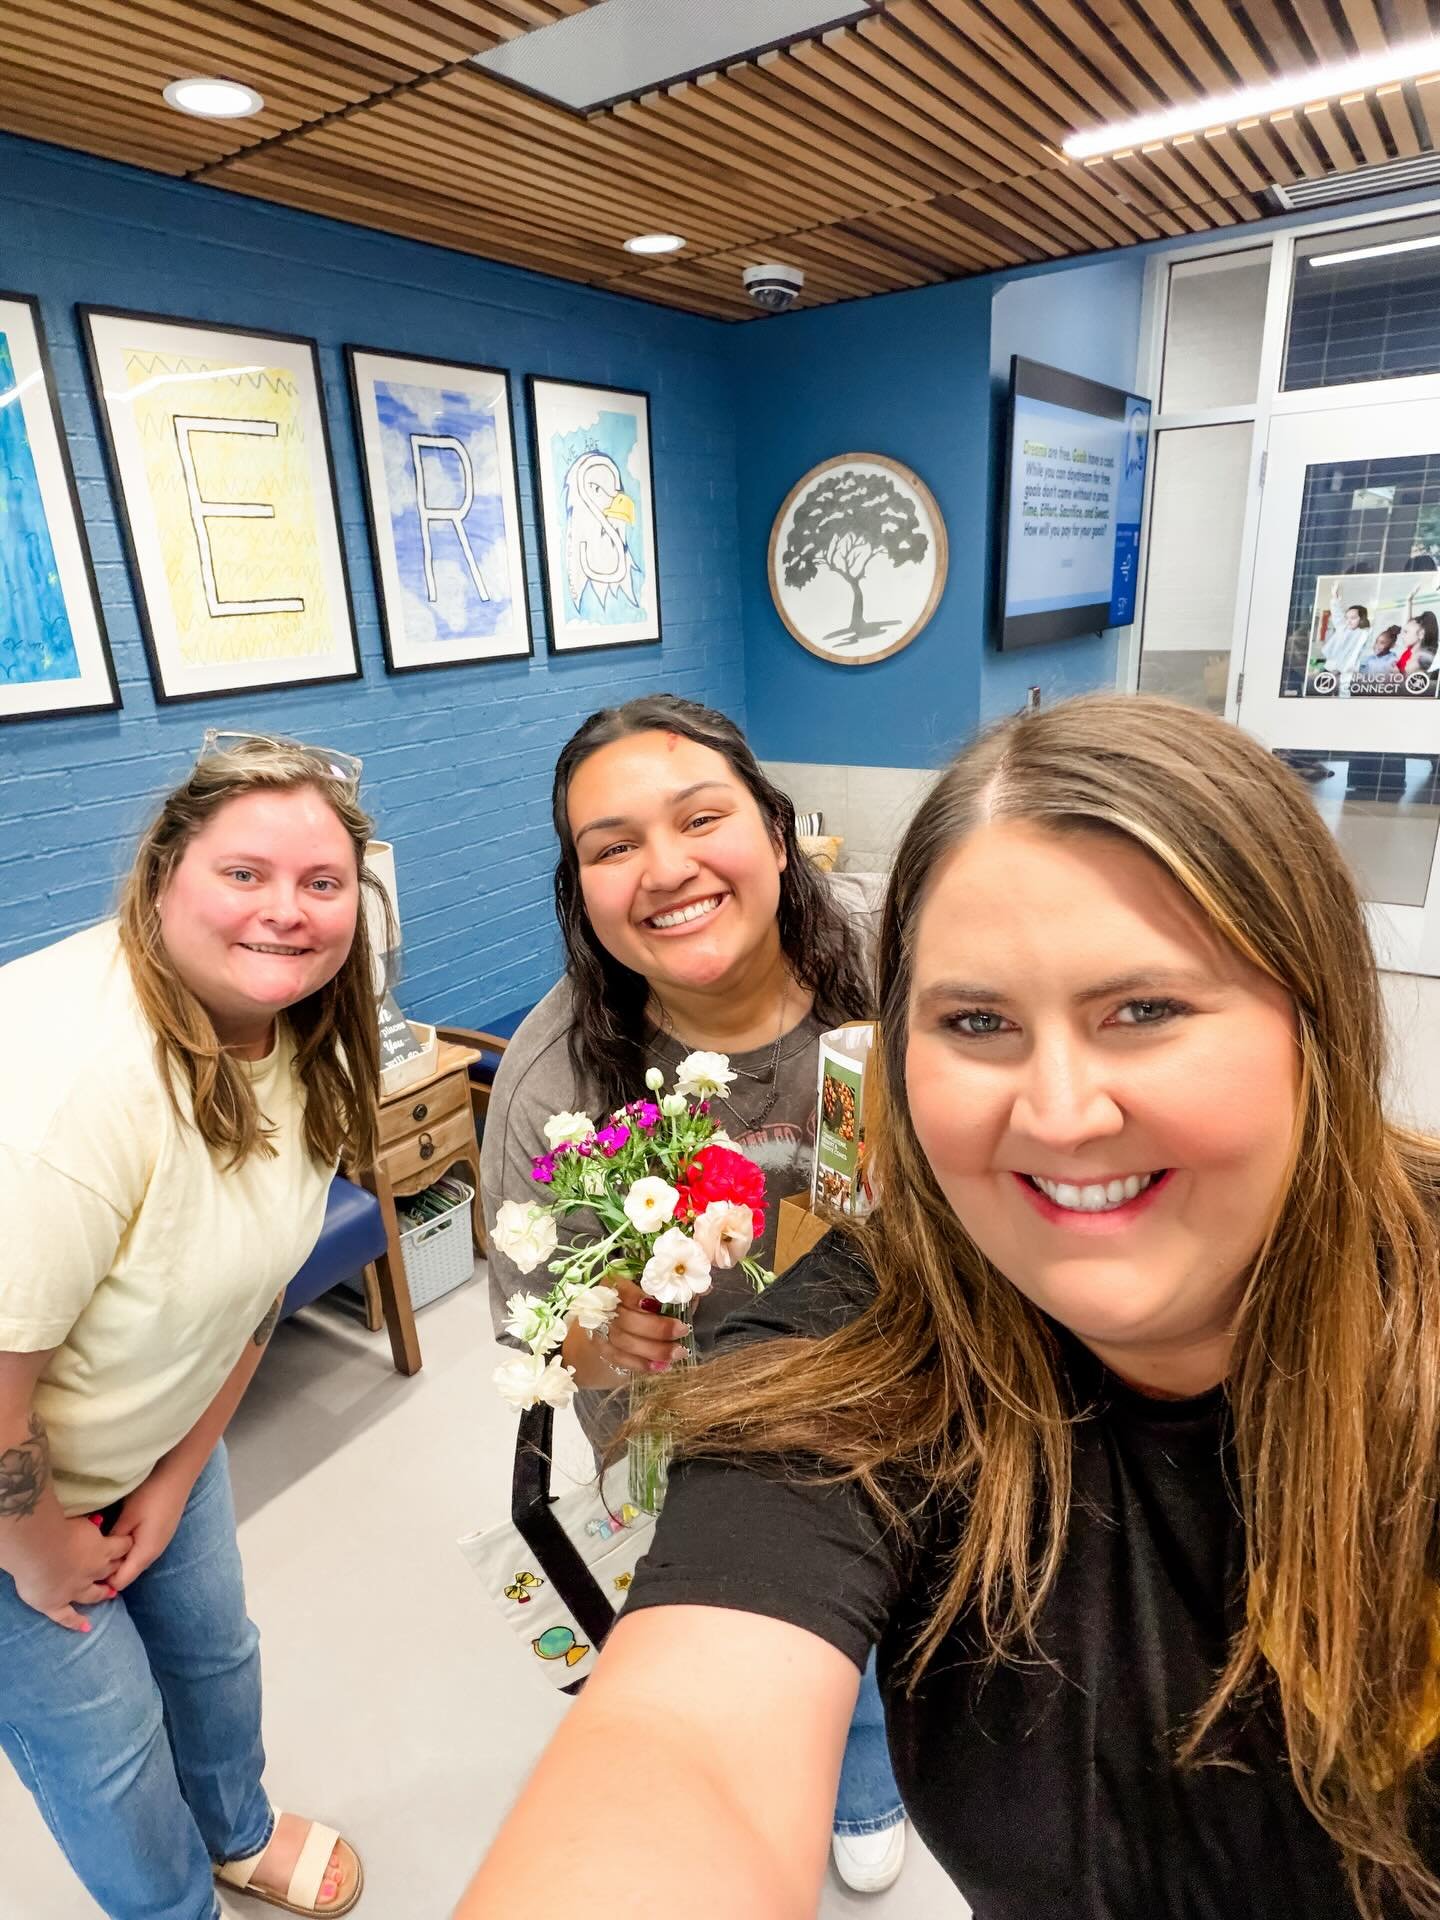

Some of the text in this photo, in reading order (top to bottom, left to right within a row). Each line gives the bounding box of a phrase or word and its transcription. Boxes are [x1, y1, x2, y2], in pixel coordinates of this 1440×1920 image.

[173, 415, 305, 618] E
[410, 433, 490, 602] R
[1342, 672, 1404, 684] NPLUG TO
